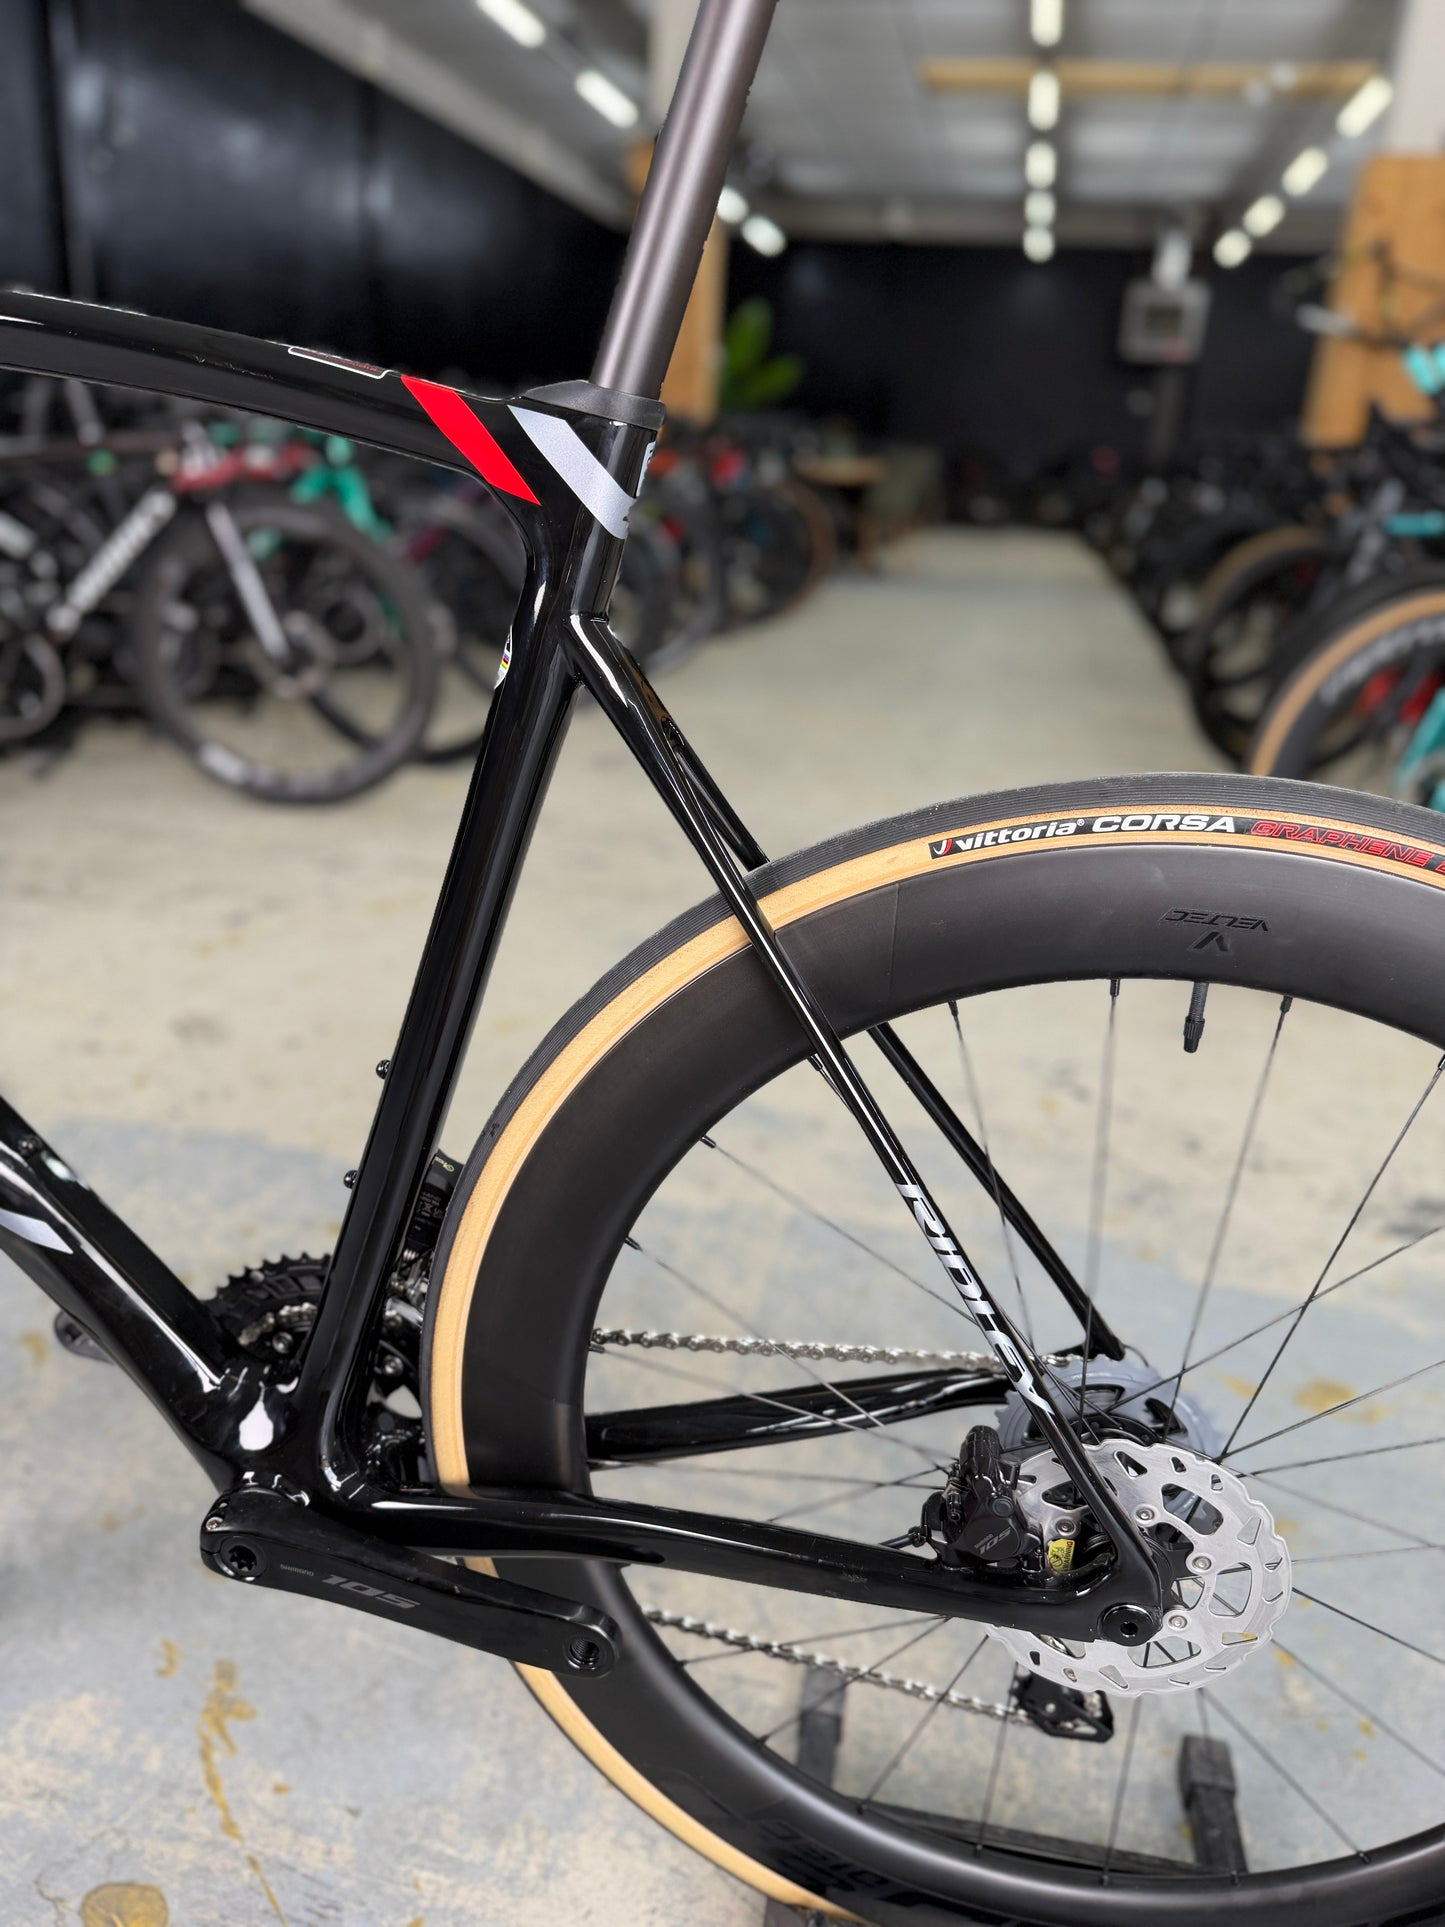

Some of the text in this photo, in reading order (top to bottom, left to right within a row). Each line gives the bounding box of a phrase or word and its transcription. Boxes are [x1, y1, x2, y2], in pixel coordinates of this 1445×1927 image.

[1091, 814, 1236, 834] CORSA
[1250, 820, 1435, 867] GRAPHENE
[1165, 911, 1268, 931] VELTEC
[896, 1184, 1055, 1415] RIDLEY
[979, 1526, 1011, 1555] 105
[321, 1574, 421, 1609] 105
